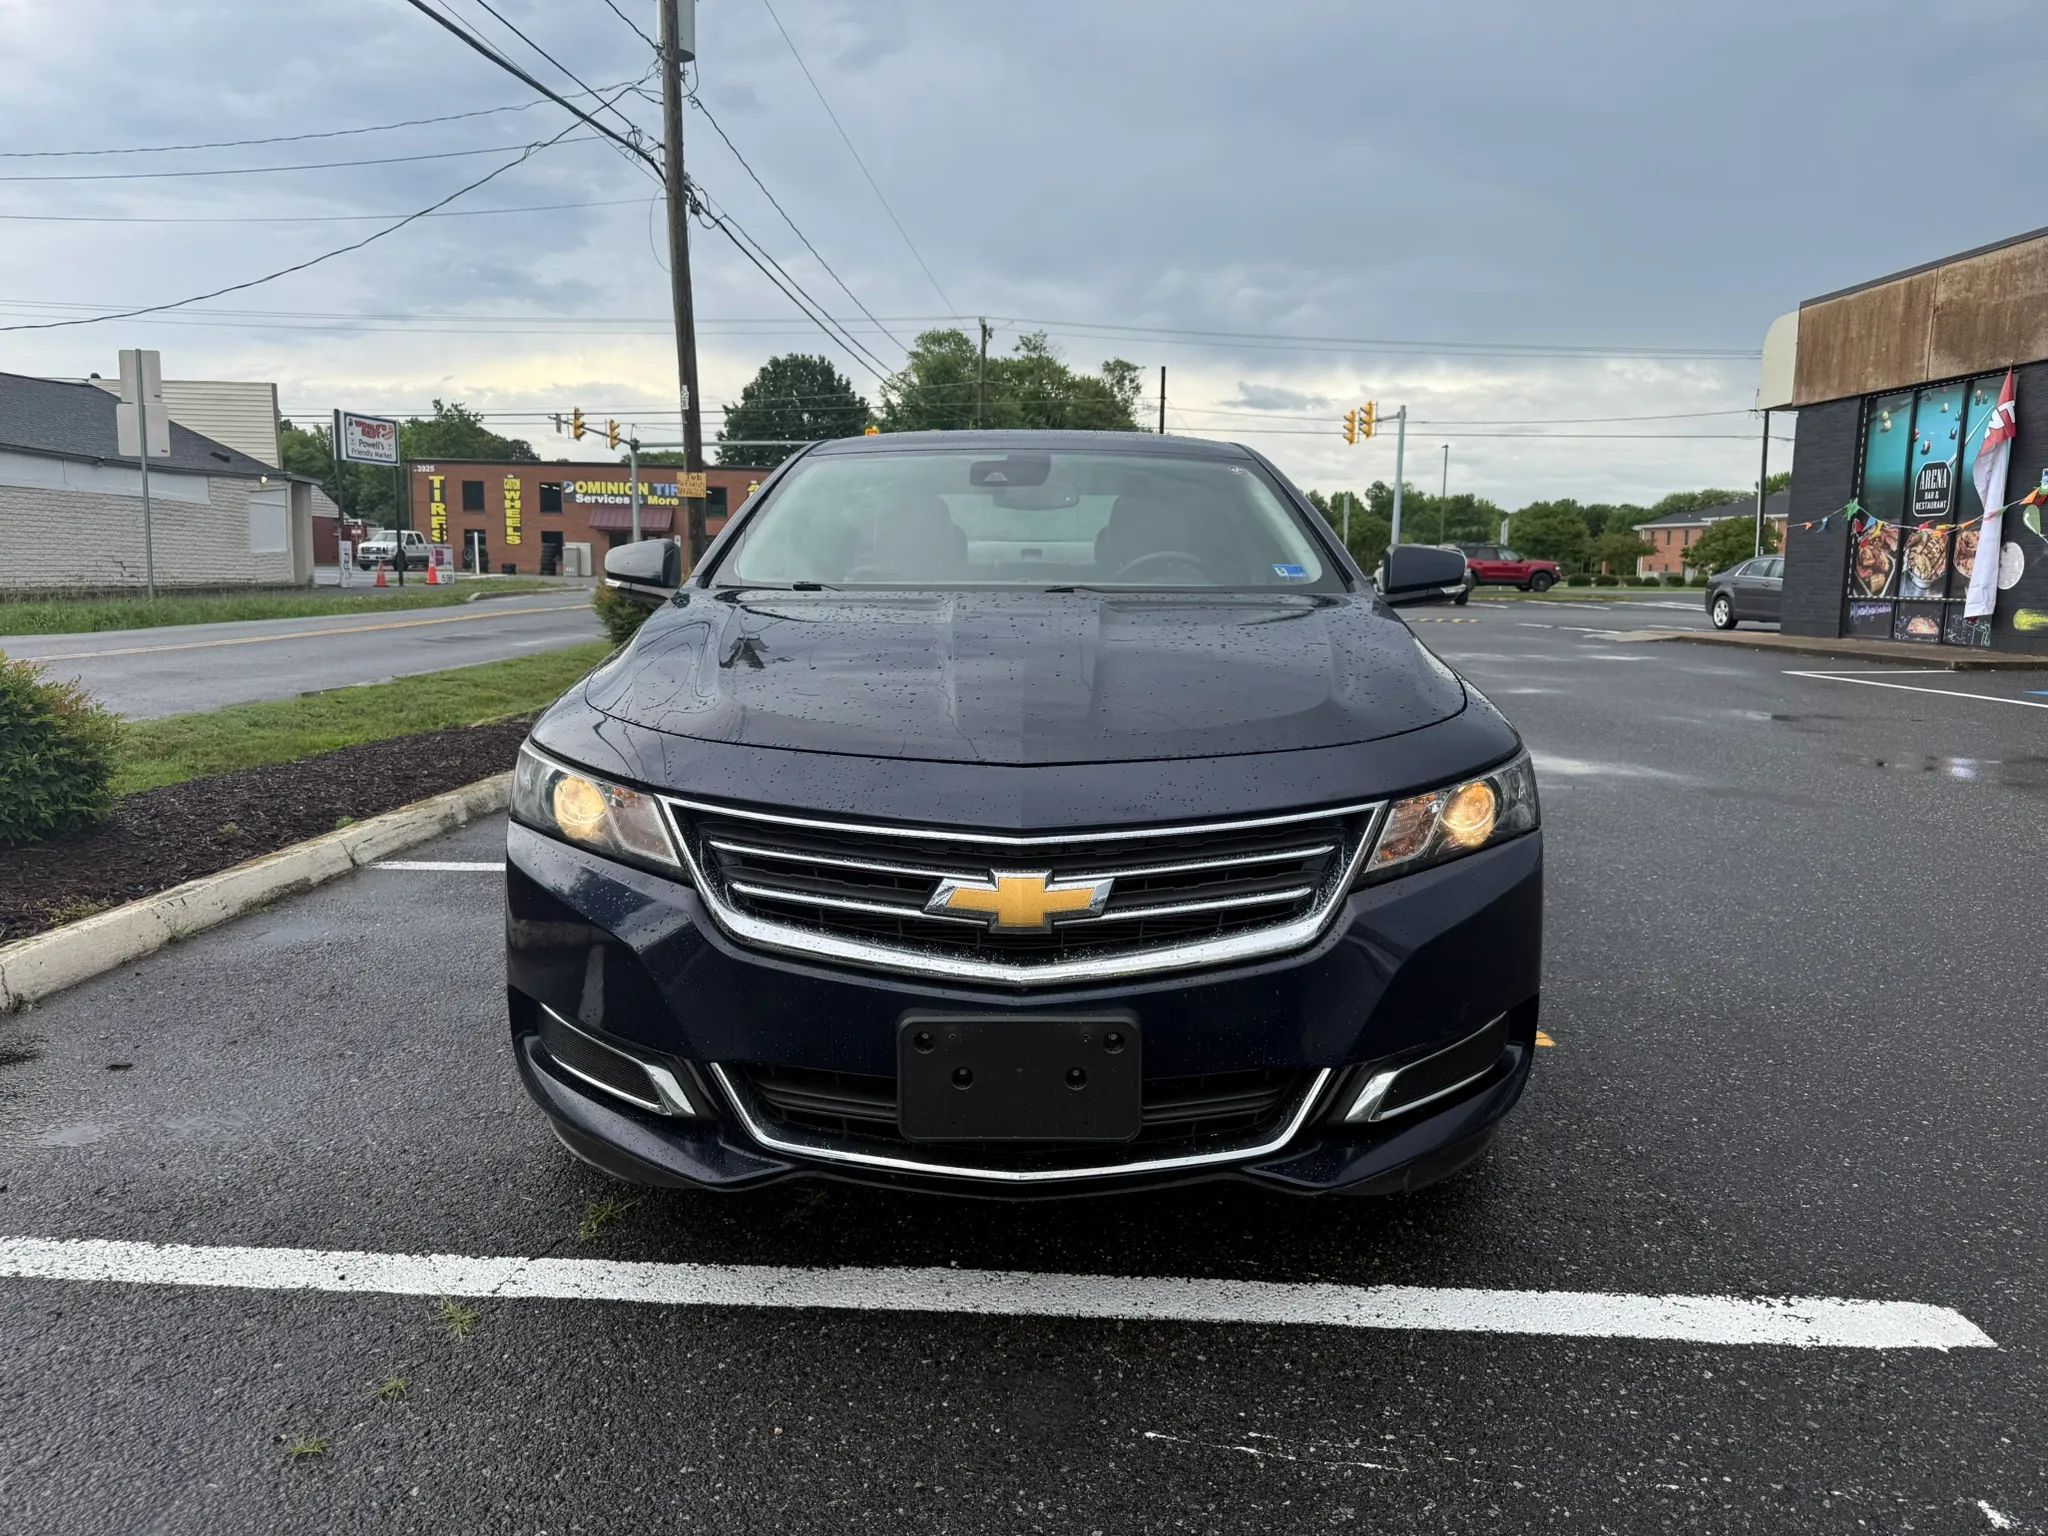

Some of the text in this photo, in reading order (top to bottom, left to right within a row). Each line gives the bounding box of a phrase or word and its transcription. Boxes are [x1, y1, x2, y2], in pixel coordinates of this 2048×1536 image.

[359, 439, 384, 450] Powell's
[352, 448, 393, 460] Friendly Market
[1919, 468, 1947, 490] ARENA
[575, 493, 630, 505] Services
[647, 495, 679, 506] More
[1924, 491, 1939, 500] BAR &
[429, 475, 448, 543] TIRES
[1915, 500, 1947, 510] RESTAURANT
[504, 490, 521, 545] WHEELS
